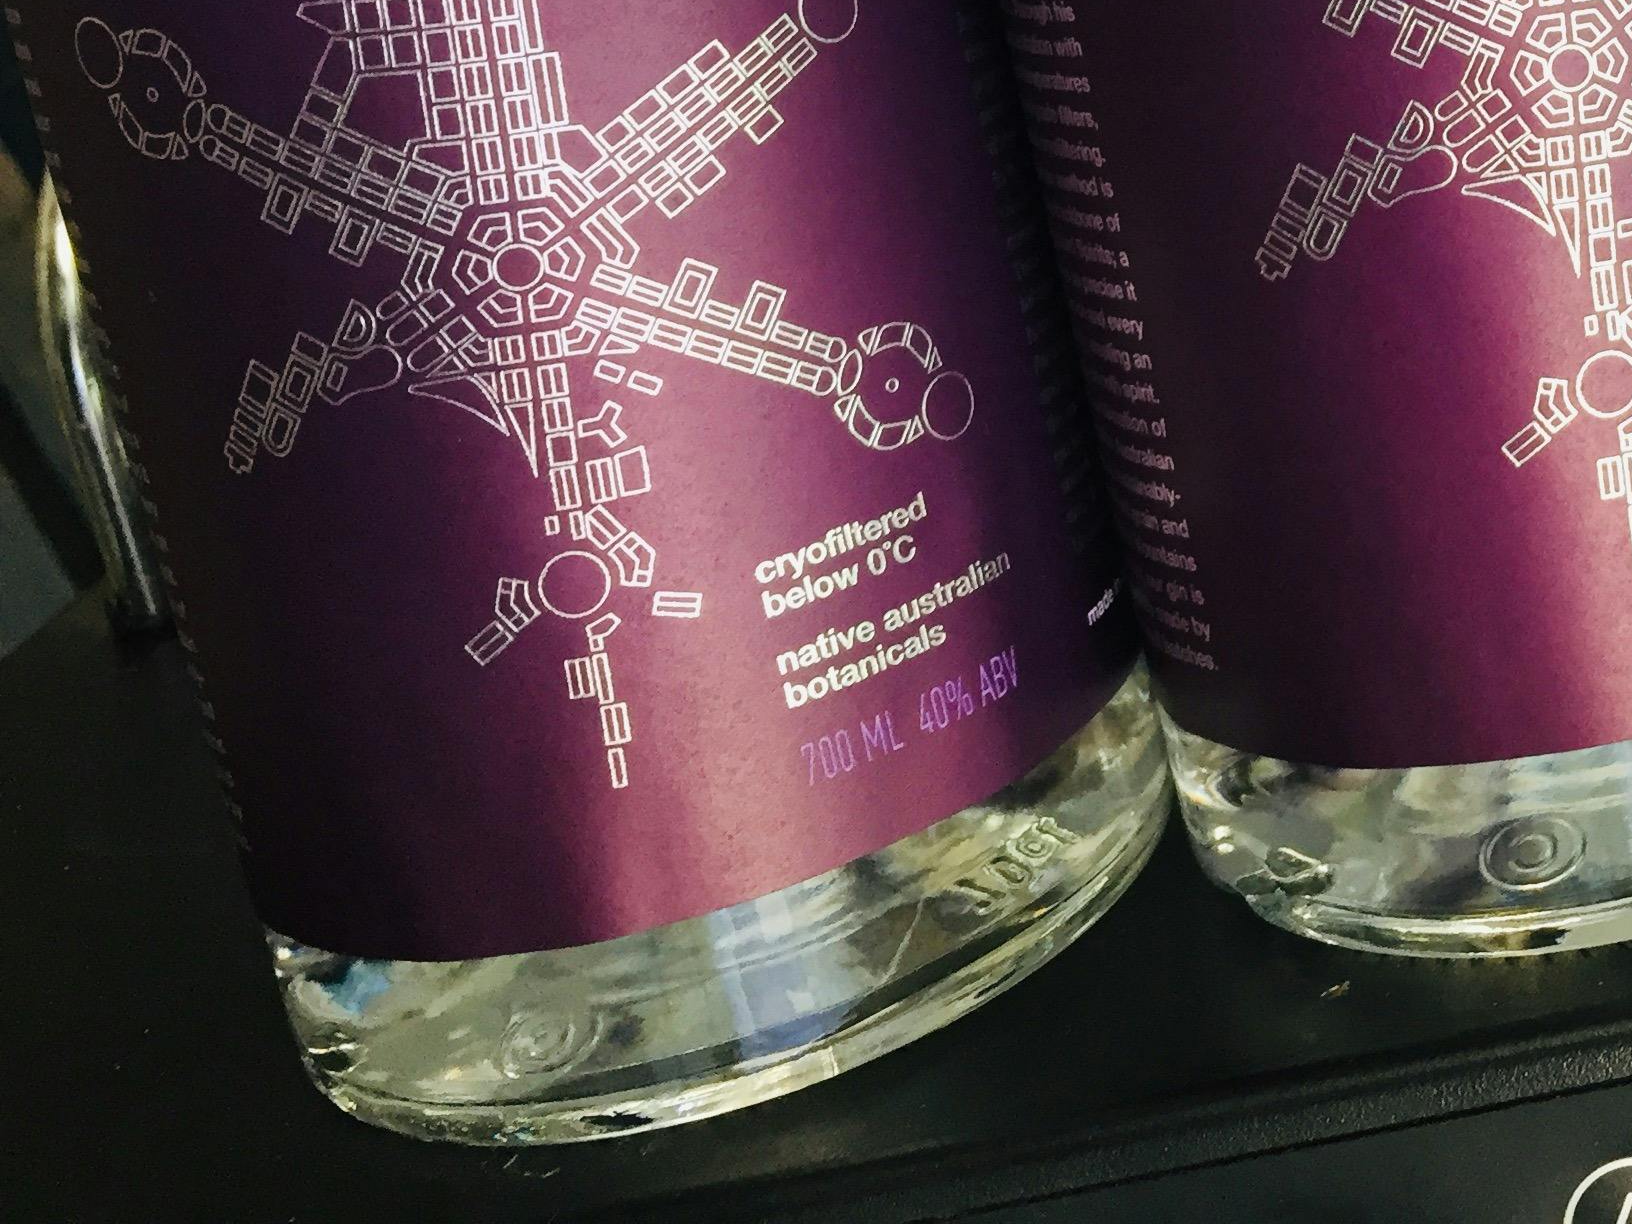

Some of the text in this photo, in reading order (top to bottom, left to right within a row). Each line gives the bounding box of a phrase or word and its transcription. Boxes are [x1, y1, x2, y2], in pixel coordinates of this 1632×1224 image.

[754, 491, 927, 584] cryofiltered
[761, 561, 860, 618] below
[776, 552, 1010, 675] native australian
[783, 624, 947, 709] botanicals
[800, 645, 1018, 785] 700 ML 40% ABV
